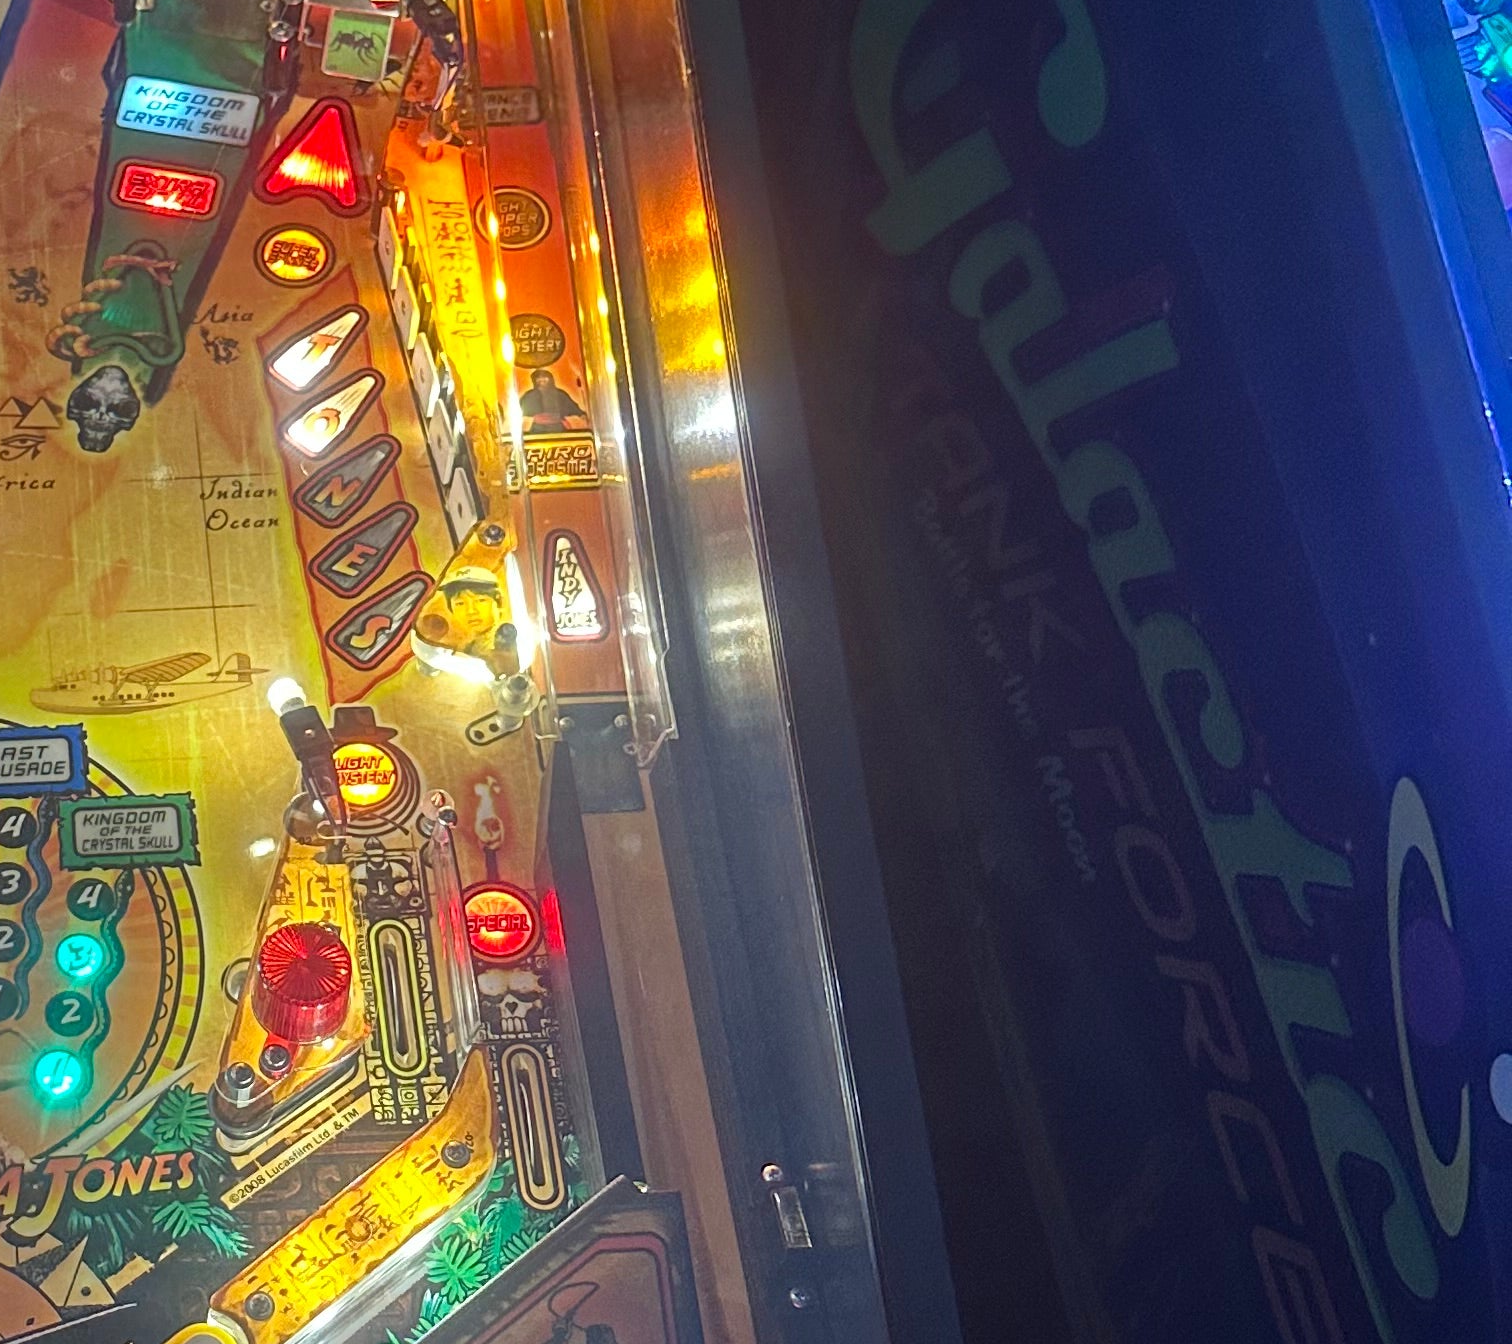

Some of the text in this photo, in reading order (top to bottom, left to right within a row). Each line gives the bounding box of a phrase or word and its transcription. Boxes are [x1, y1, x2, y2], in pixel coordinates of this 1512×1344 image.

[135, 85, 246, 111] KINGDOM
[146, 100, 226, 121] OF THE
[121, 110, 250, 141] CRYSTAL SKULL
[131, 173, 210, 193] EXTRA
[192, 303, 255, 325] Asia
[514, 338, 562, 355] YSTERY
[199, 480, 279, 502] Indian
[205, 509, 280, 532] Ocean
[334, 755, 385, 771] LIGHT
[81, 809, 167, 827] KINGDOM
[1037, 754, 1098, 884] Moon
[99, 823, 154, 836] OF THE
[80, 833, 176, 853] CRYSTAL SKULL
[464, 913, 530, 934] SPECIAL
[266, 1143, 314, 1178] Lucasfilm
[341, 1107, 360, 1124] TM
[12, 1151, 197, 1238] JONES
